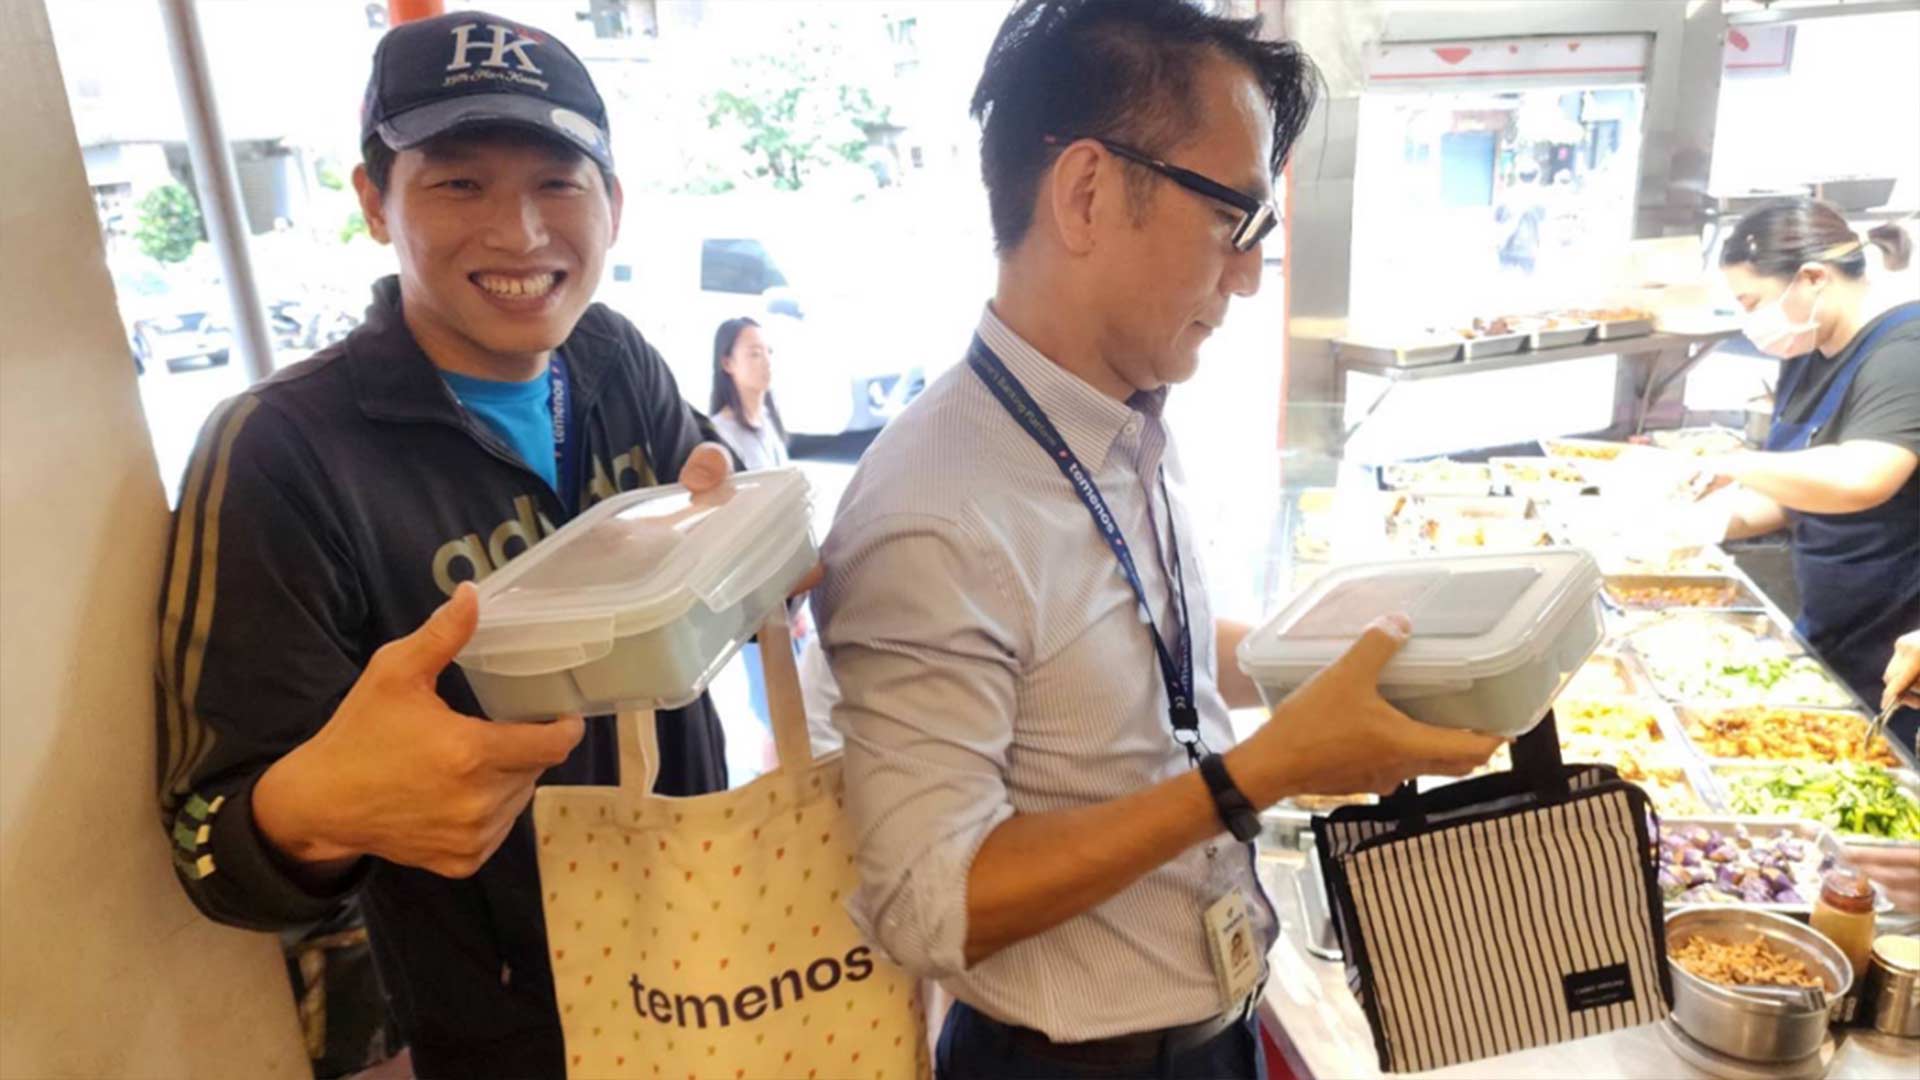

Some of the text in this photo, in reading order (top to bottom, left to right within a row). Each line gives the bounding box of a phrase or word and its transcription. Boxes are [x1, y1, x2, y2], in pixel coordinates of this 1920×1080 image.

[446, 23, 543, 75] HK
[552, 379, 566, 445] temenos
[1068, 462, 1115, 535] temenos
[628, 944, 875, 1030] temenos
